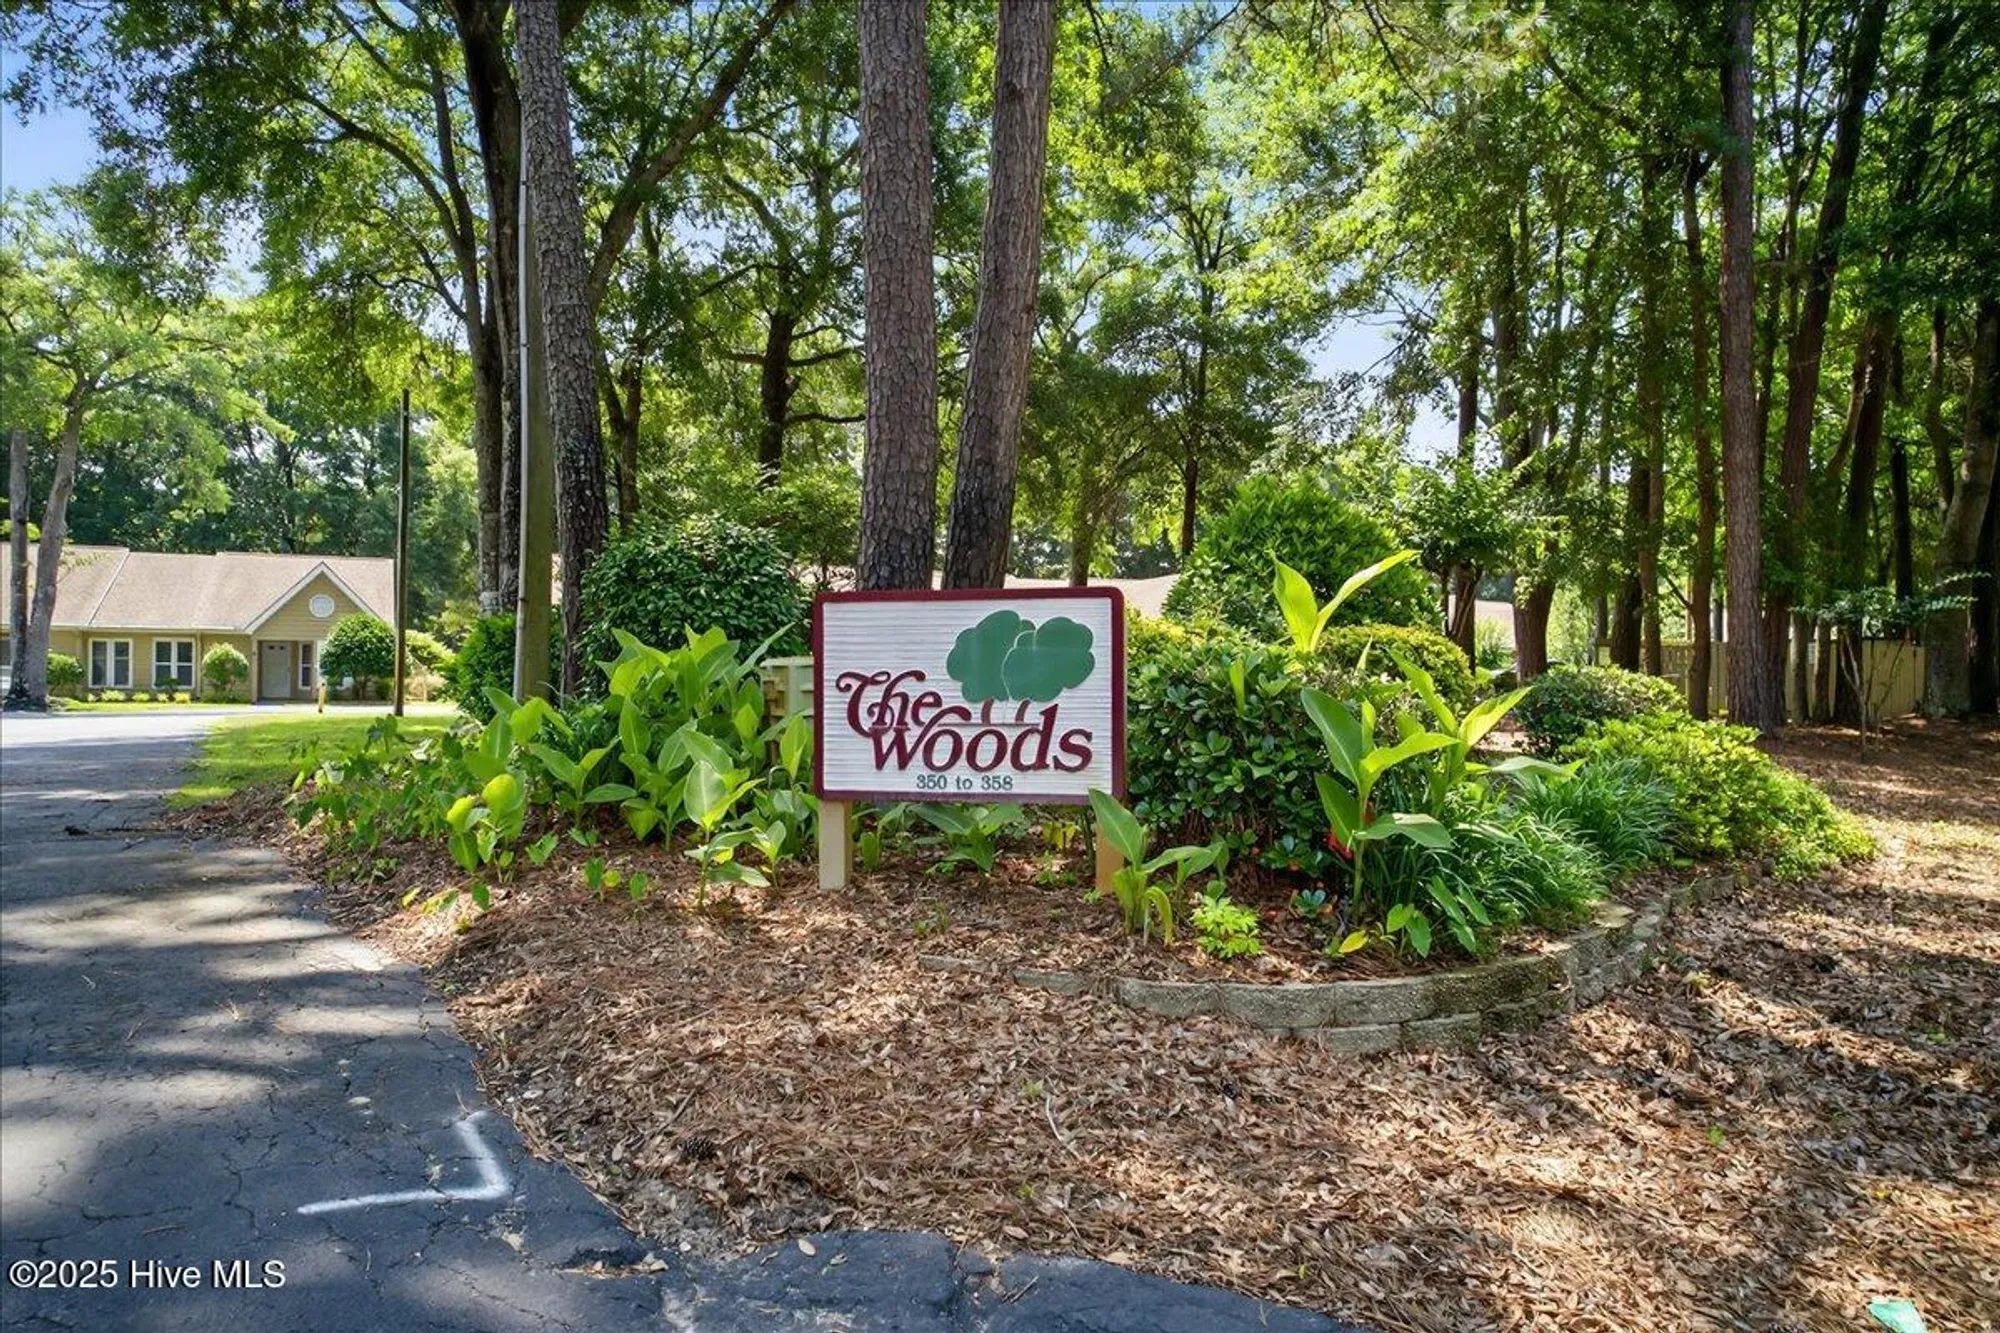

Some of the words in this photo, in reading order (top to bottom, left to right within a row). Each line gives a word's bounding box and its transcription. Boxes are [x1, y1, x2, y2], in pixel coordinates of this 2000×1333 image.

[835, 670, 943, 738] The
[868, 703, 1093, 773] Woods
[916, 774, 947, 790] 350
[955, 775, 973, 791] to
[981, 775, 1014, 791] 358
